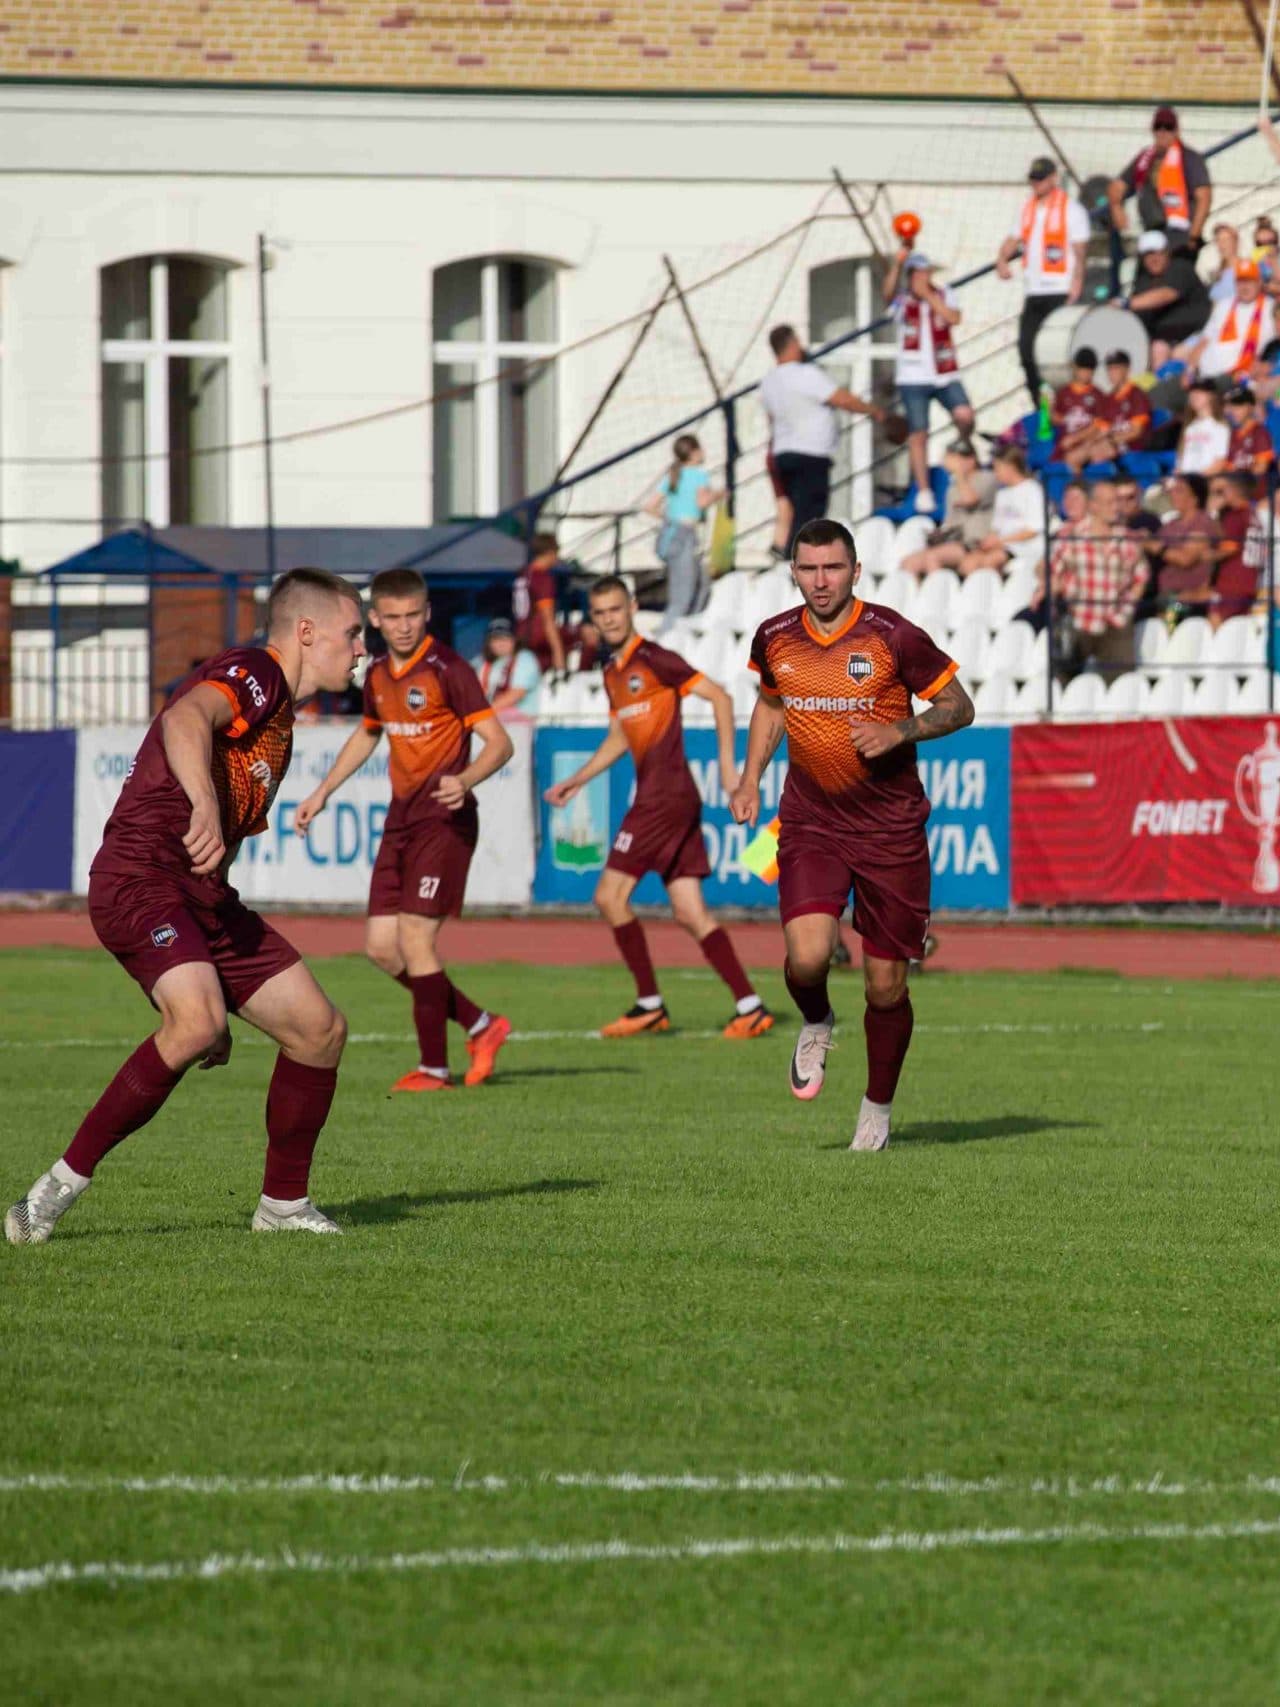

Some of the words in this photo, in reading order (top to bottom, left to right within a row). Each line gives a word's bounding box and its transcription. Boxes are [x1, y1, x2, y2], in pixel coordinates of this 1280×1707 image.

[245, 675, 267, 707] ПСБ
[1131, 800, 1229, 837] FONBET
[419, 876, 441, 900] 27
